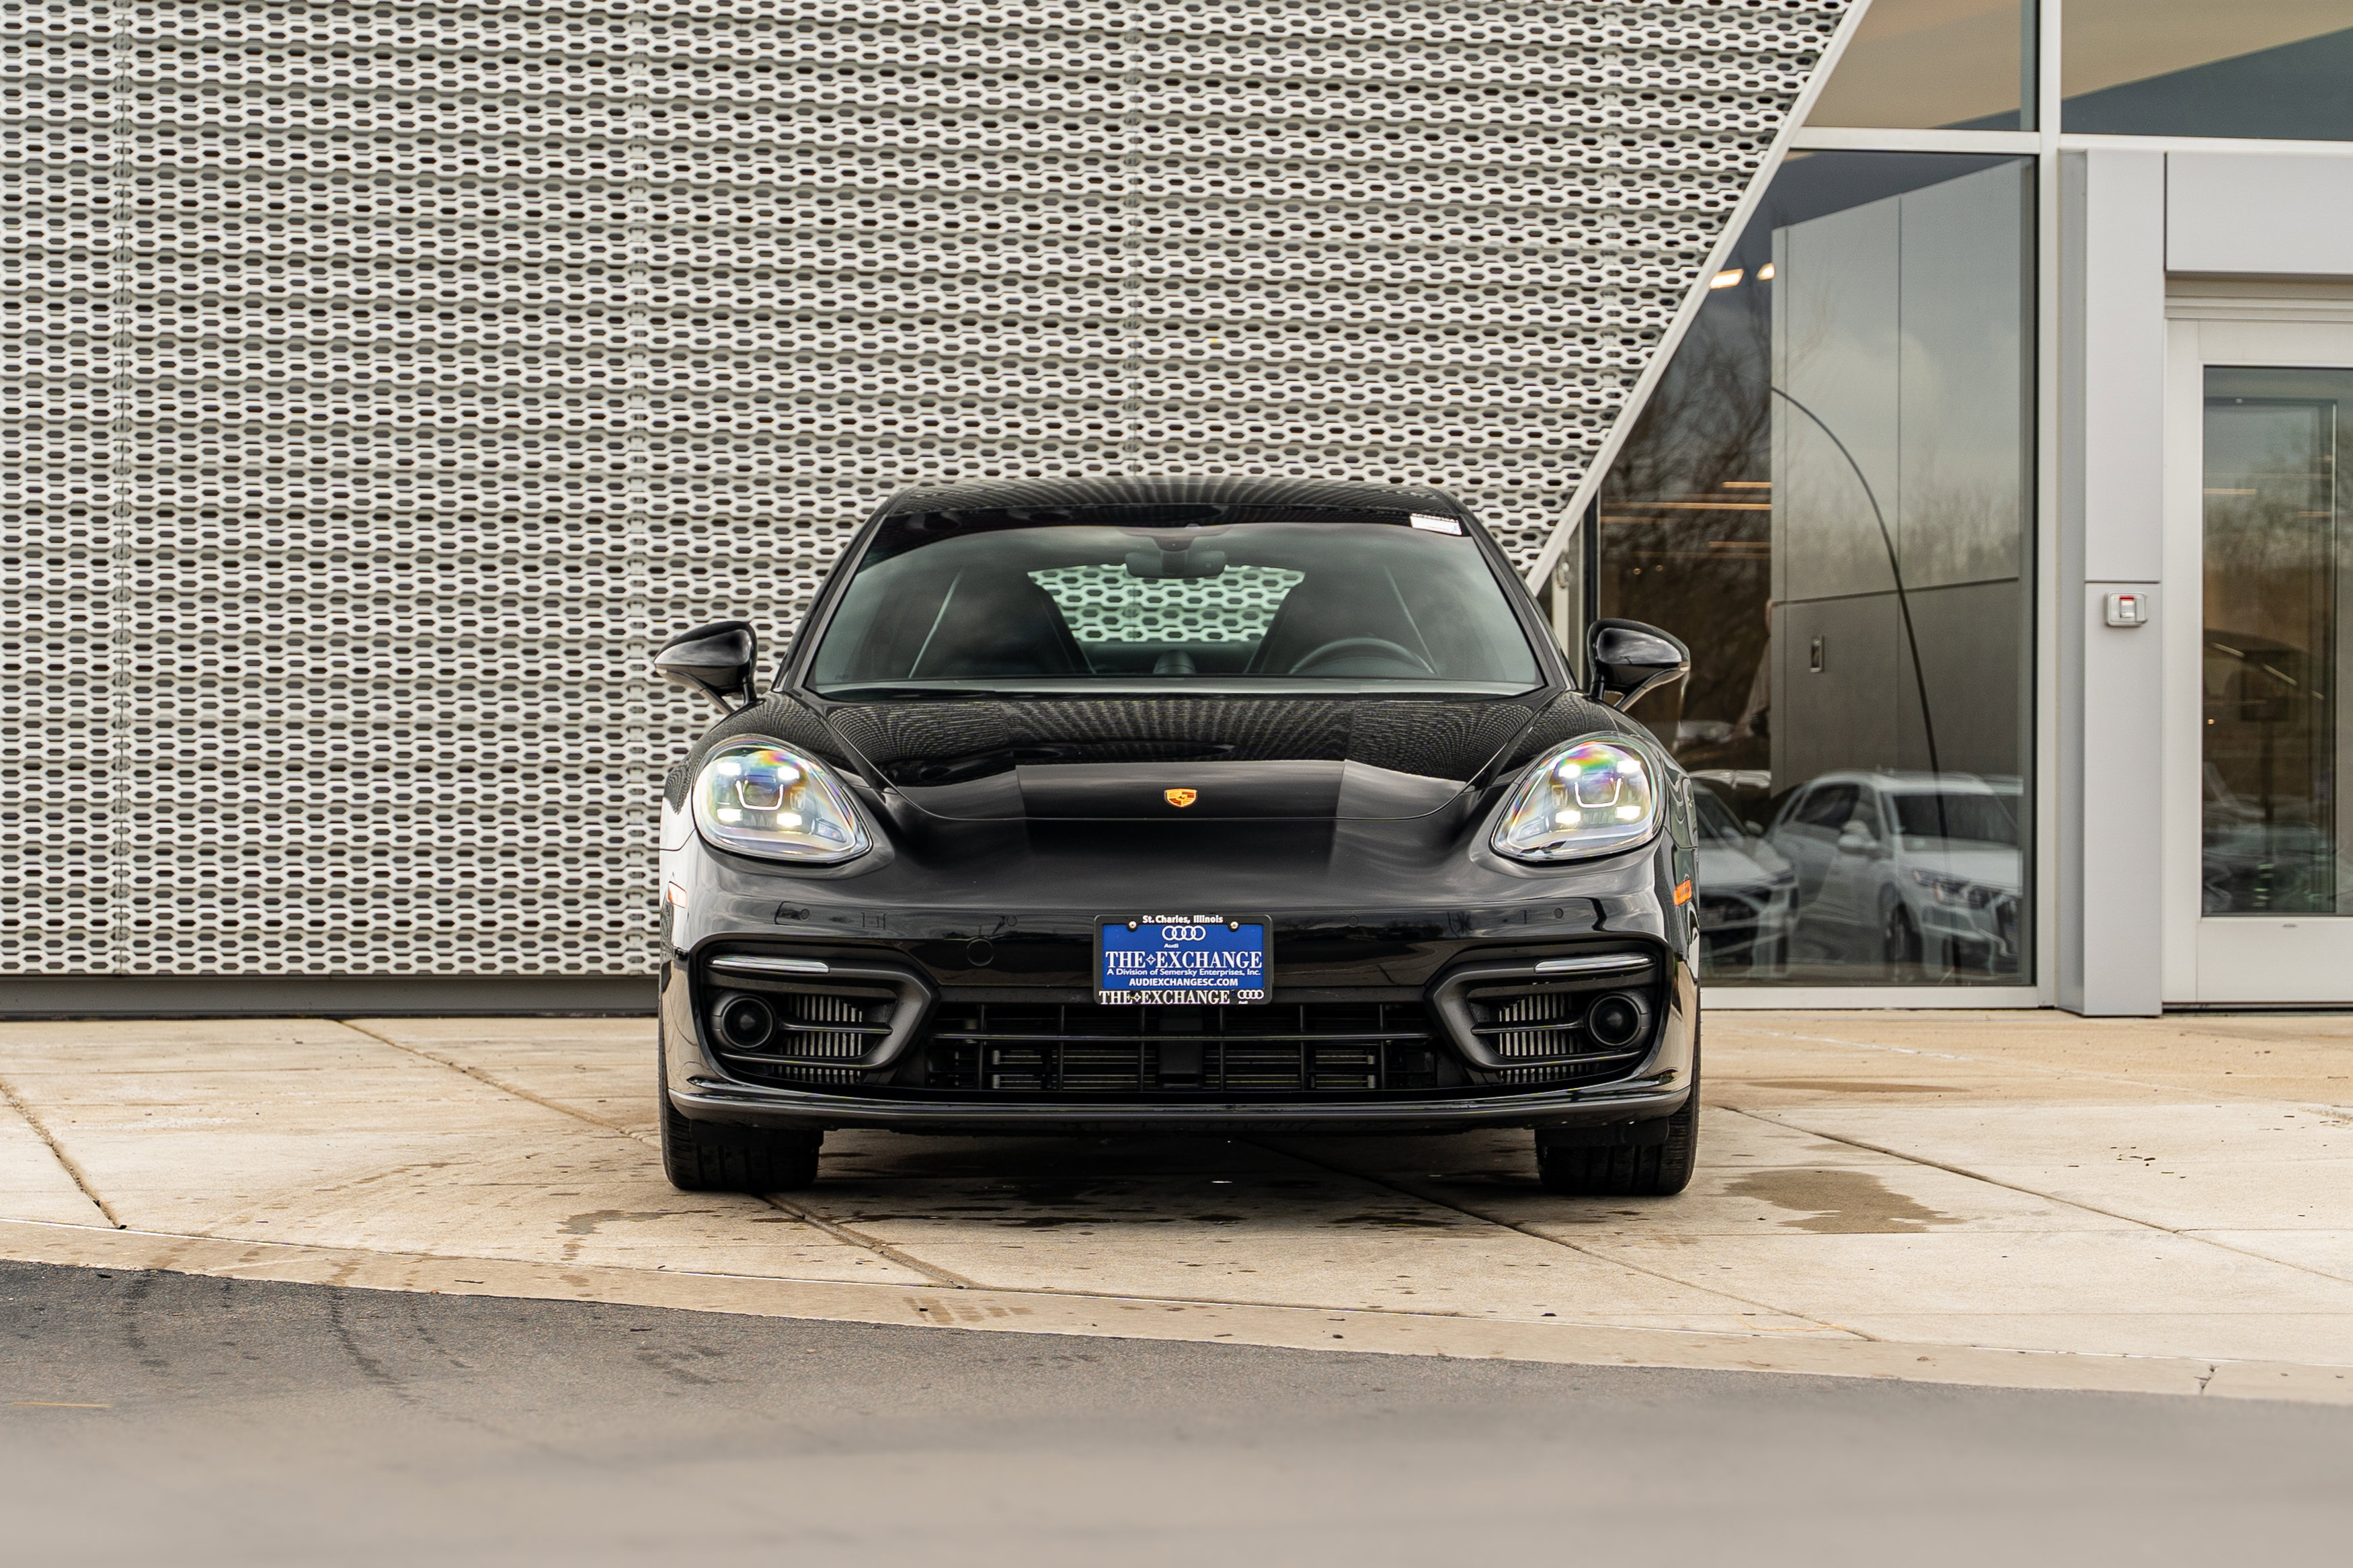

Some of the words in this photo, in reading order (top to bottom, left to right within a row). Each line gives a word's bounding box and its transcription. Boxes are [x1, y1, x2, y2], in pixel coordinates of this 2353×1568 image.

[1156, 915, 1191, 923] Charles,
[1193, 915, 1224, 923] Illinois
[1105, 951, 1146, 968] THE
[1155, 951, 1263, 968] EXCHANGE
[1160, 968, 1197, 977] Semersky
[1199, 968, 1245, 977] Enterprises,
[1129, 978, 1238, 986] AUDIEXCHANGESC.COM
[1099, 991, 1133, 1004] THE
[1140, 990, 1230, 1004] EXCHANGE
